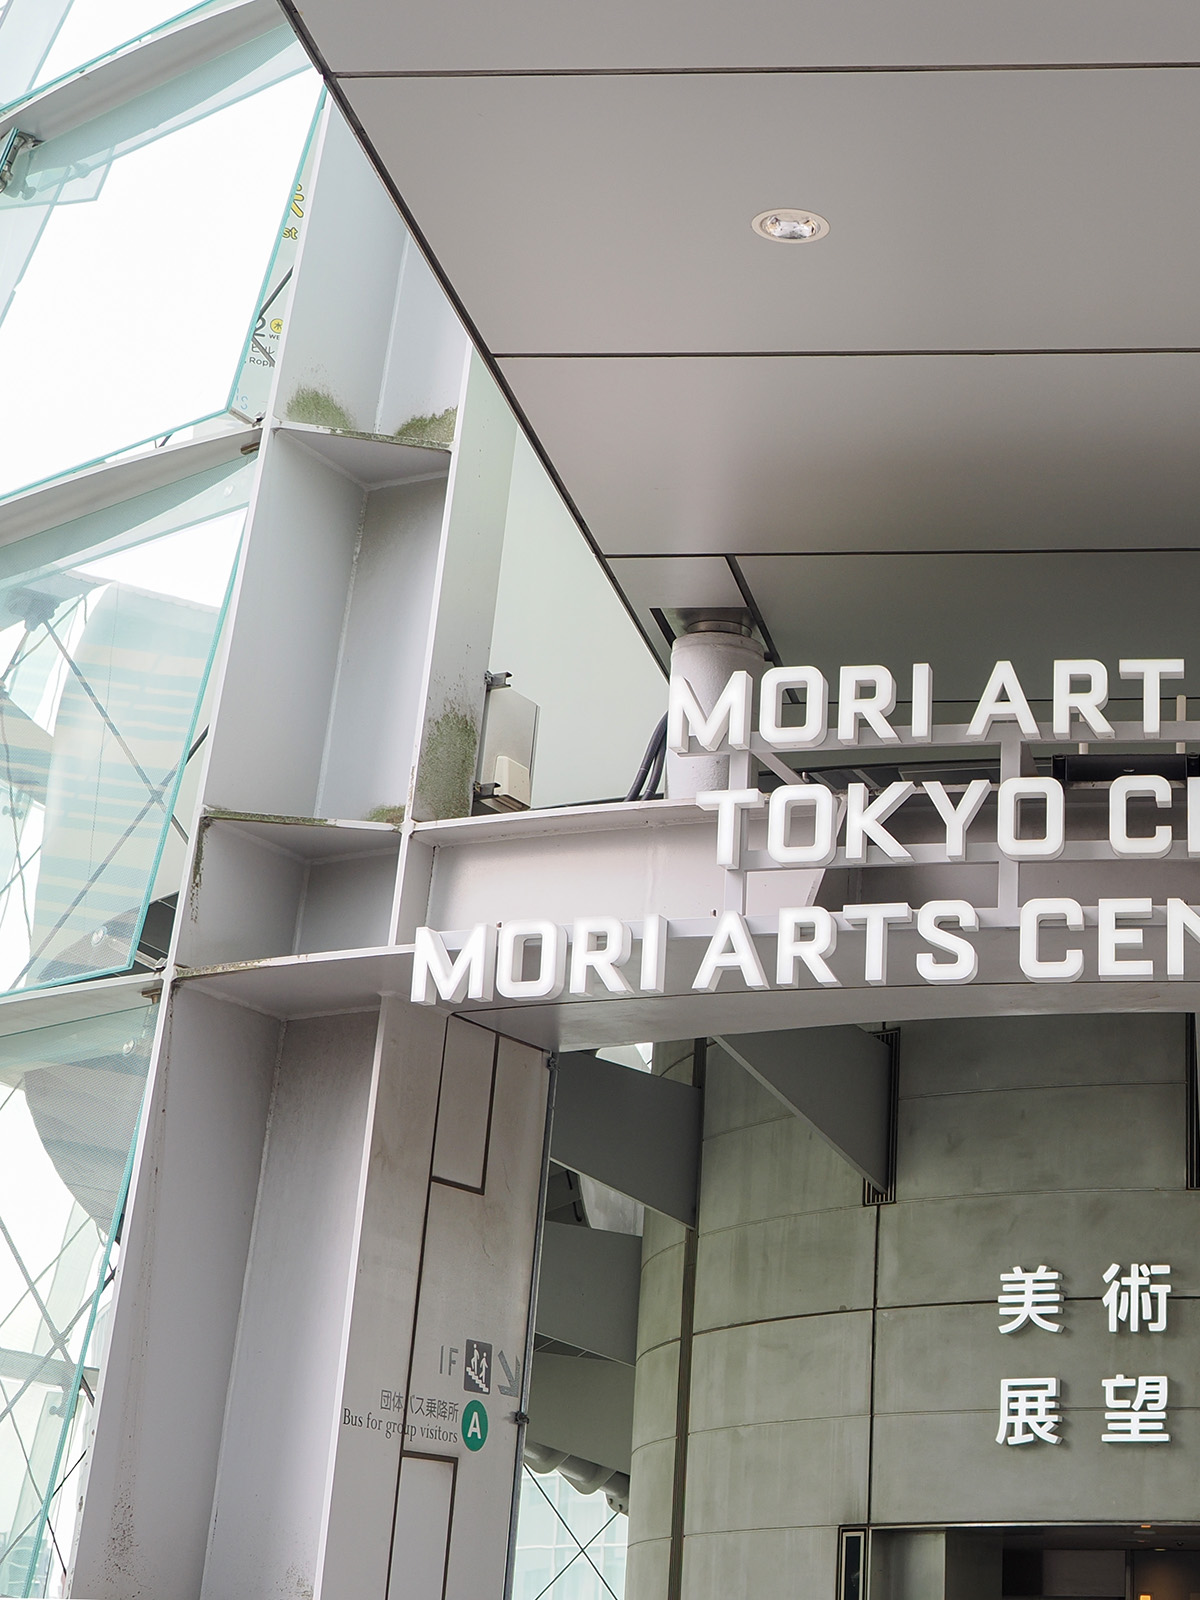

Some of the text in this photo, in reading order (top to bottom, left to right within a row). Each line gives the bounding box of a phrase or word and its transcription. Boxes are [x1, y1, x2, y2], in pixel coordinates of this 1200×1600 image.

[668, 663, 932, 754] MORI
[966, 658, 1185, 741] ART
[696, 776, 1066, 870] TOKYO
[410, 913, 668, 1006] MORI
[691, 899, 979, 992] ARTS
[343, 1408, 363, 1428] Bus
[366, 1411, 383, 1431] for
[420, 1423, 458, 1443] visitors
[467, 1411, 482, 1439] A
